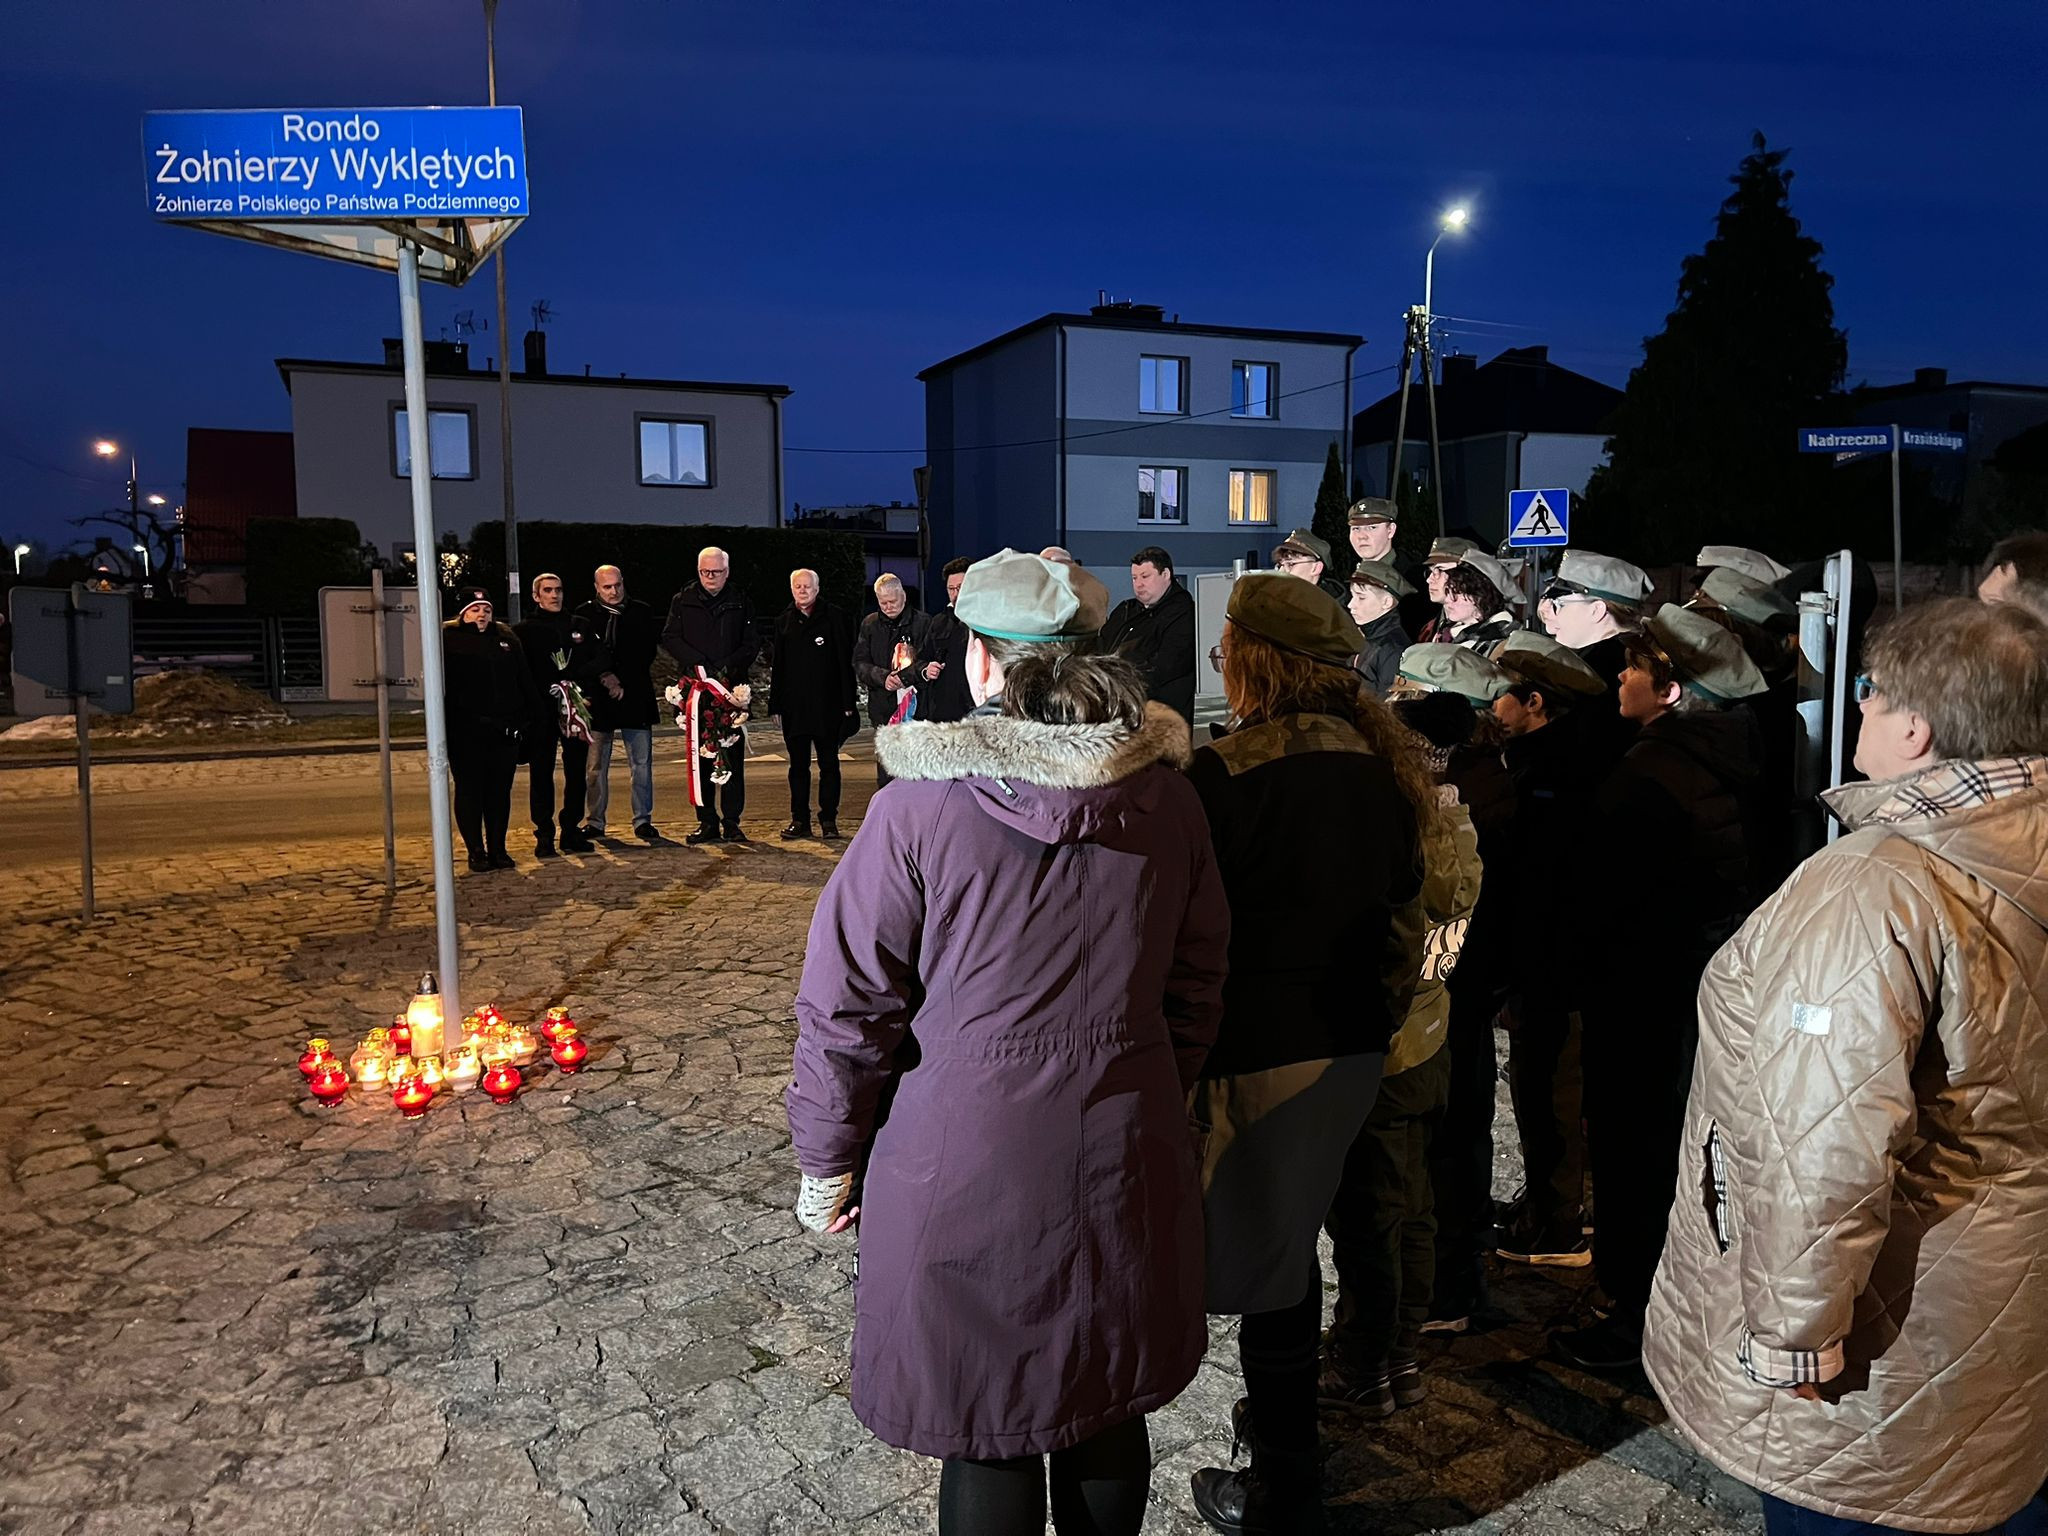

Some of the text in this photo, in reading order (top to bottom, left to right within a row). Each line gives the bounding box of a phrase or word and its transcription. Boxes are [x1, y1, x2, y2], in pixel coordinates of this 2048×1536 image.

[283, 114, 380, 142] Rondo
[156, 144, 515, 190] Żołnierzy Wyklętych
[155, 193, 520, 215] Żołnierze Polskiego Państwa Podziemnego
[1808, 433, 1887, 447] Nadrzeczna
